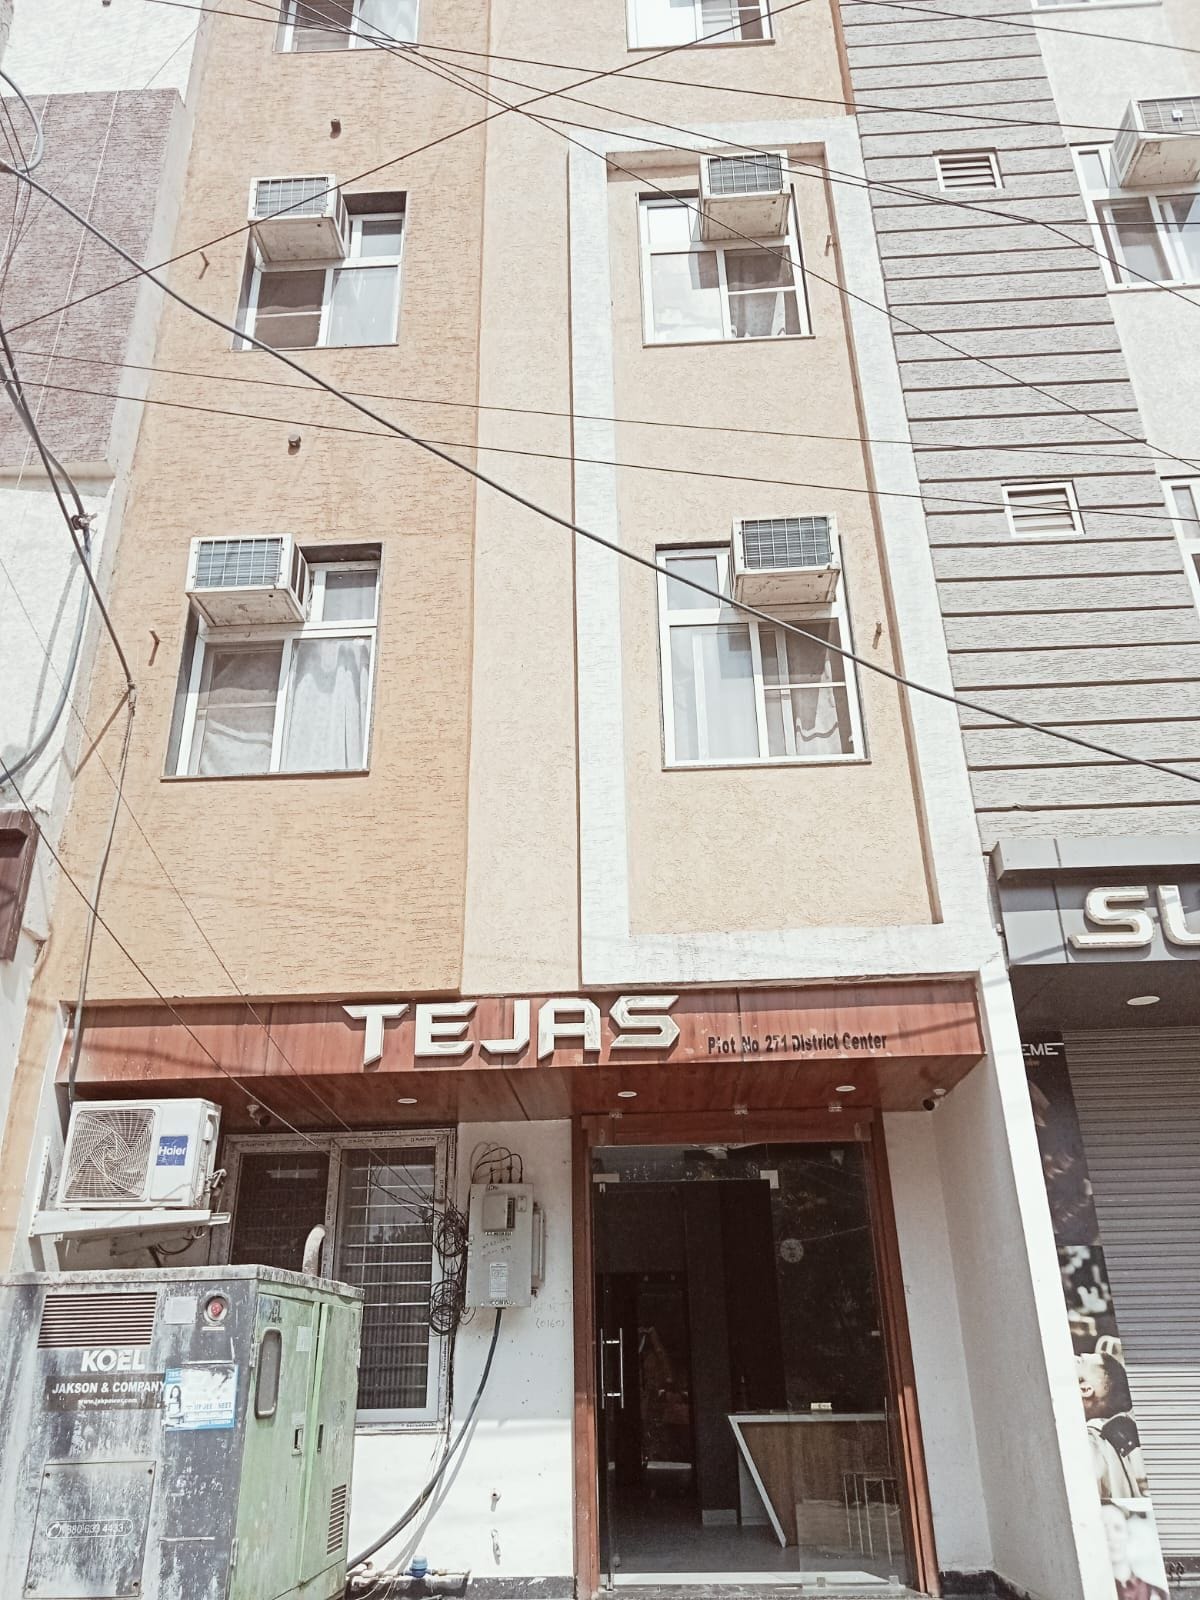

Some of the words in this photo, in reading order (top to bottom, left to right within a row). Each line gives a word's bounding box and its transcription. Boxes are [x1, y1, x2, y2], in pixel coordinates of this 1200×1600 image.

[342, 995, 681, 1066] TEJAS
[742, 1036, 760, 1054] No
[792, 1033, 840, 1052] District
[842, 1032, 887, 1050] Center
[159, 1145, 186, 1156] Haier
[80, 1349, 146, 1372] KOEL
[52, 1381, 99, 1394] JAKSON
[101, 1381, 110, 1393] &
[113, 1380, 165, 1393] COMPANY
